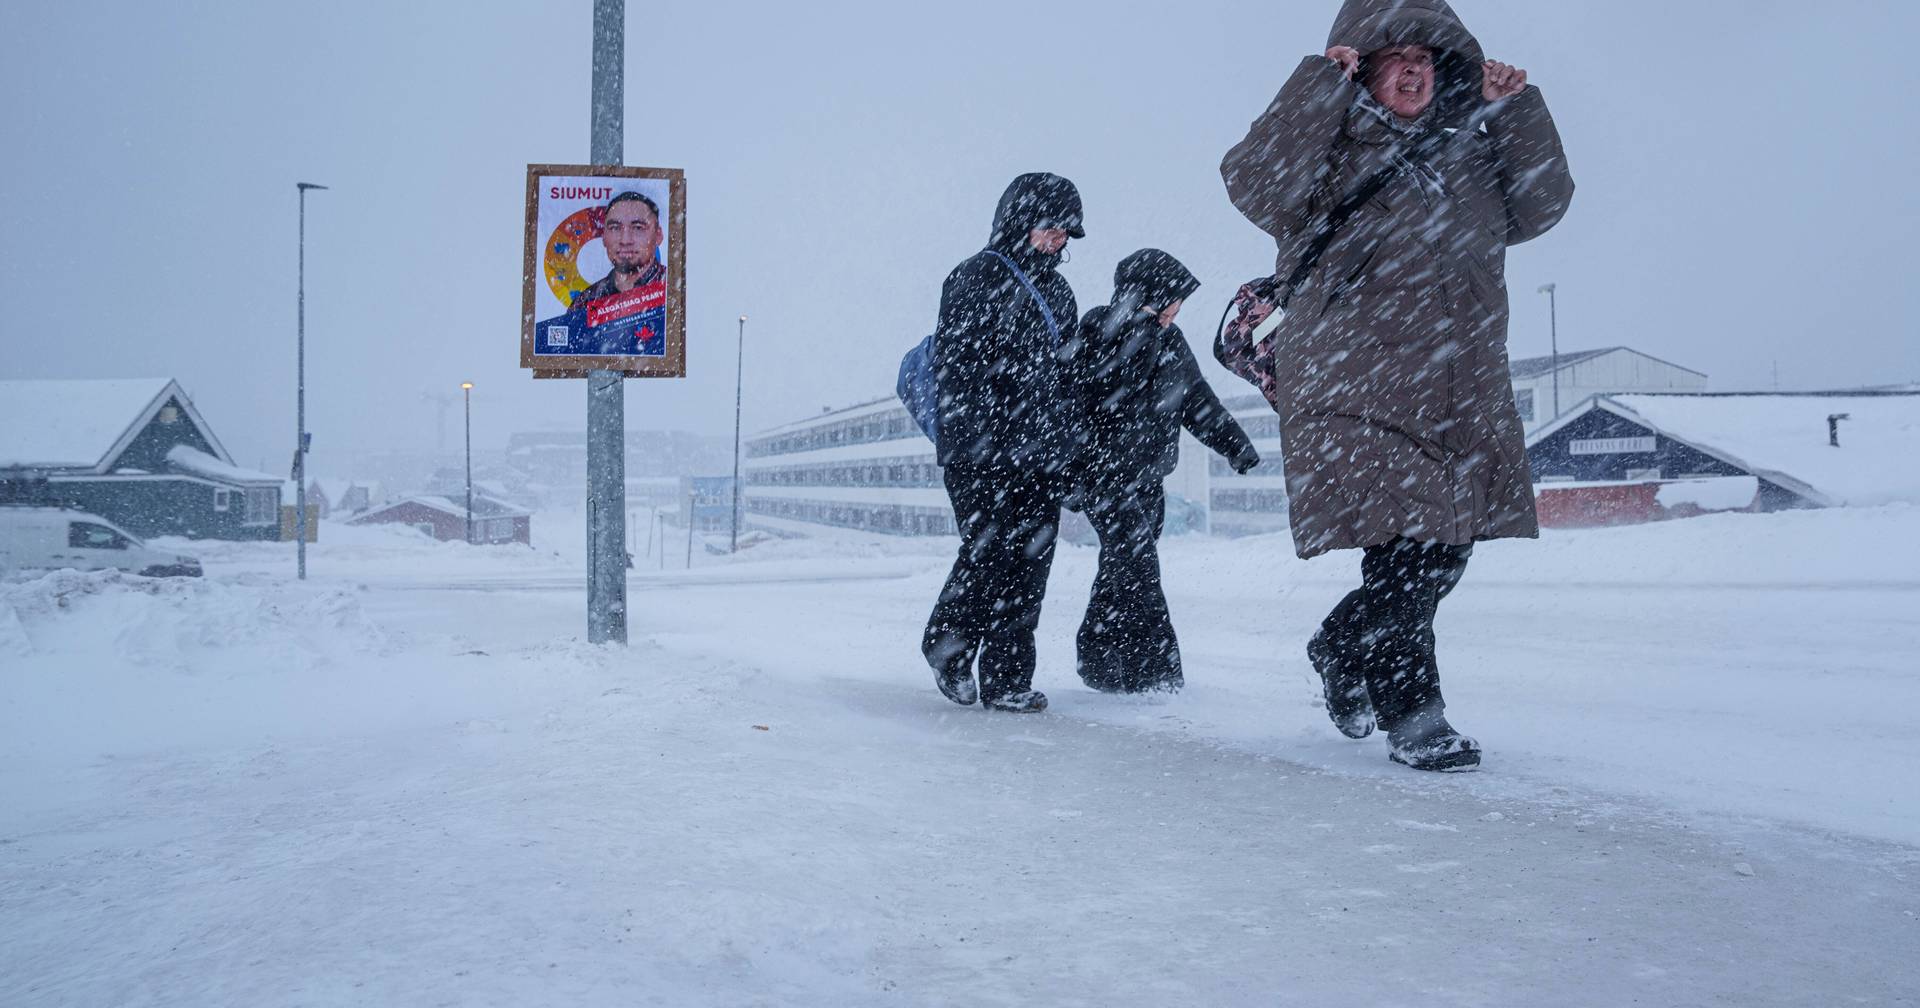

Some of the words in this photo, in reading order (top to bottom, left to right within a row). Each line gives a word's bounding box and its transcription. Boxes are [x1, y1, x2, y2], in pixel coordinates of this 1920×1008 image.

[550, 187, 613, 200] SIUMUT
[597, 298, 641, 316] ALEQATSIAQ
[641, 291, 664, 302] PEARY
